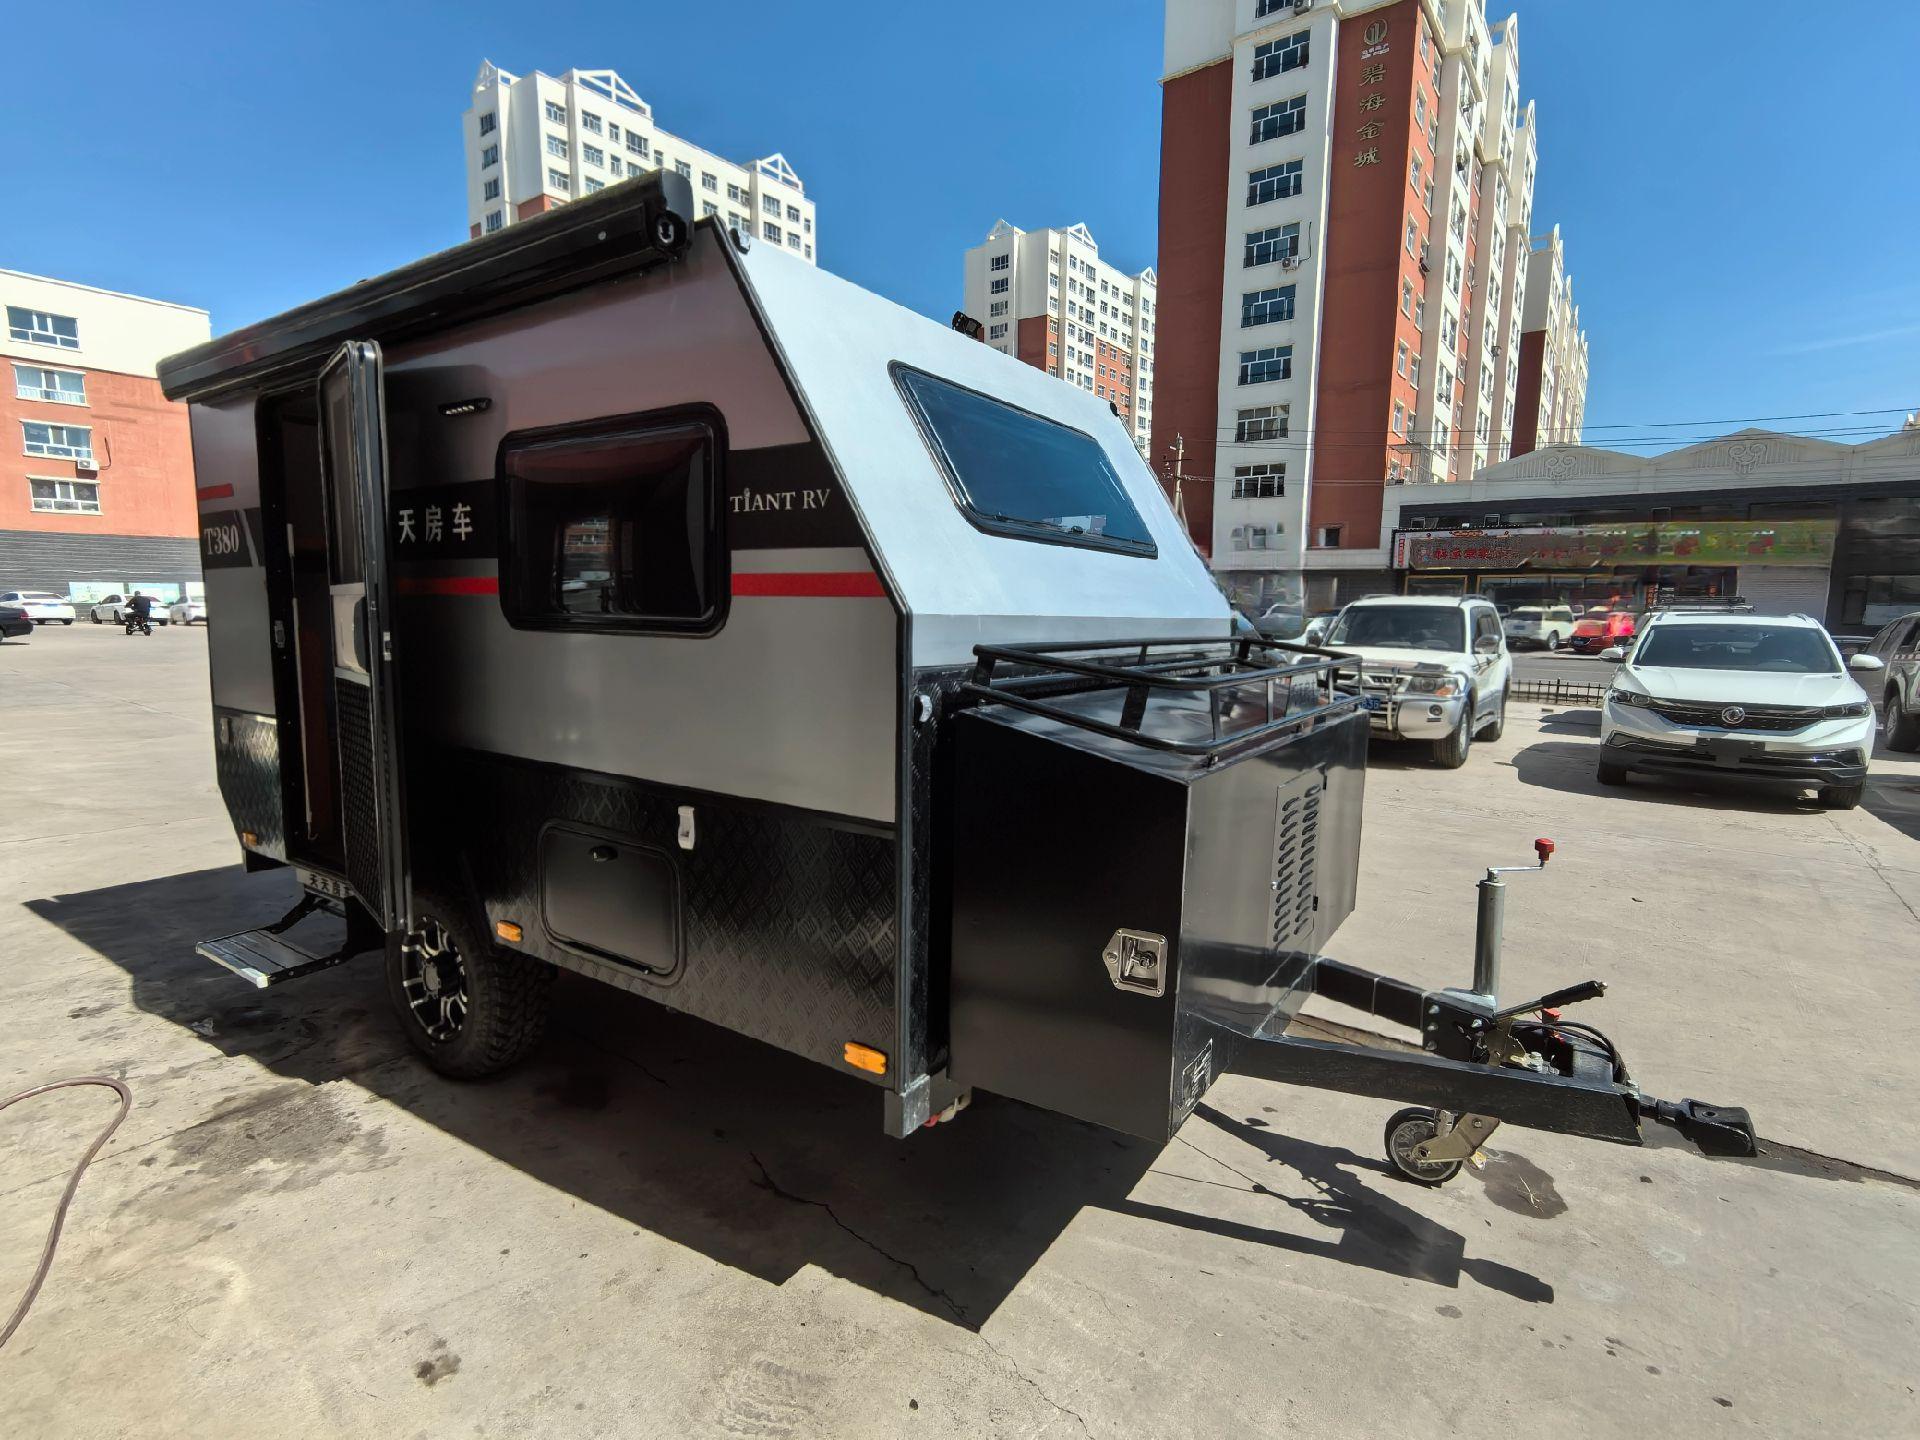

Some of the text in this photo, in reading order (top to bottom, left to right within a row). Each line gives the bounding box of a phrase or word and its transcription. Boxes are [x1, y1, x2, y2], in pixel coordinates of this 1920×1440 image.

[1354, 63, 1387, 168] 碧海金城
[802, 488, 831, 509] RV
[203, 525, 240, 555] T380
[398, 502, 473, 544] 天房车
